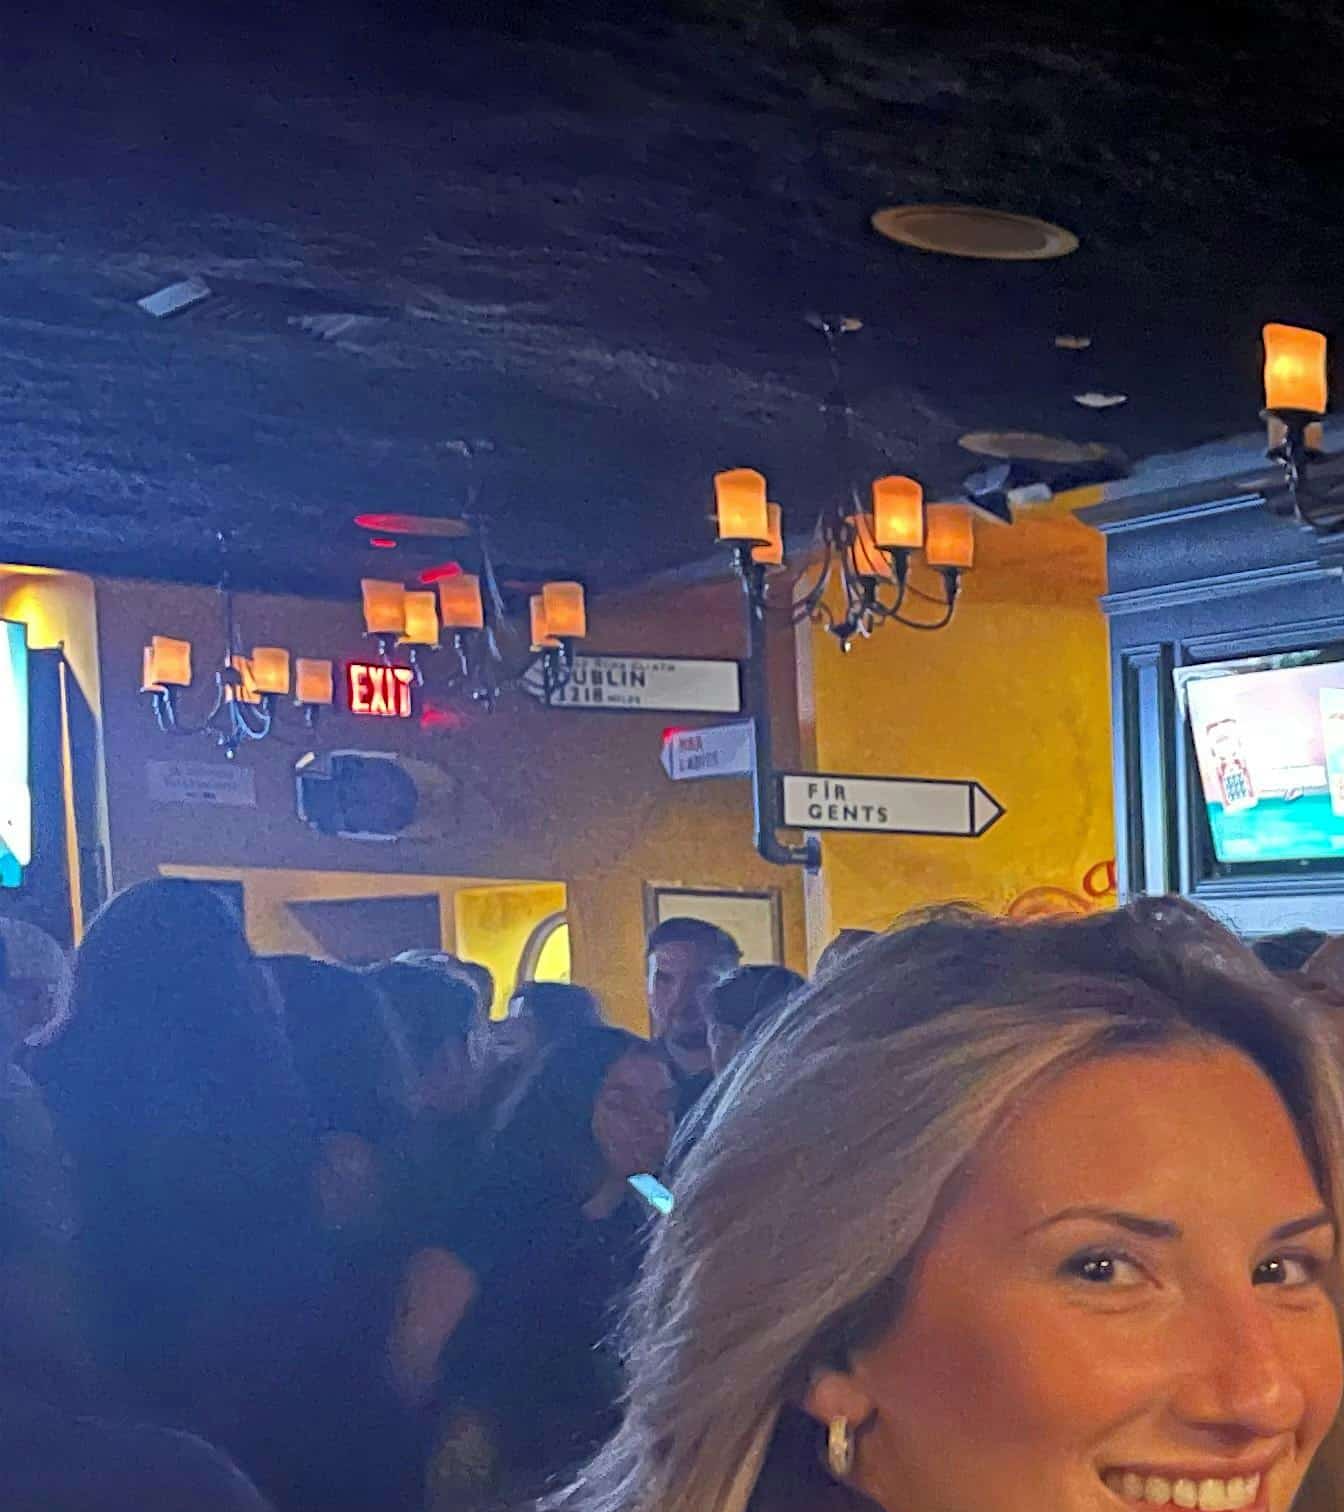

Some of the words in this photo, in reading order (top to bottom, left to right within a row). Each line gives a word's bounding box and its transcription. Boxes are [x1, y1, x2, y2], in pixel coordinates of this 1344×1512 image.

[572, 668, 646, 688] UBLIN
[349, 664, 414, 717] EXIT
[807, 803, 889, 823] GENTS
